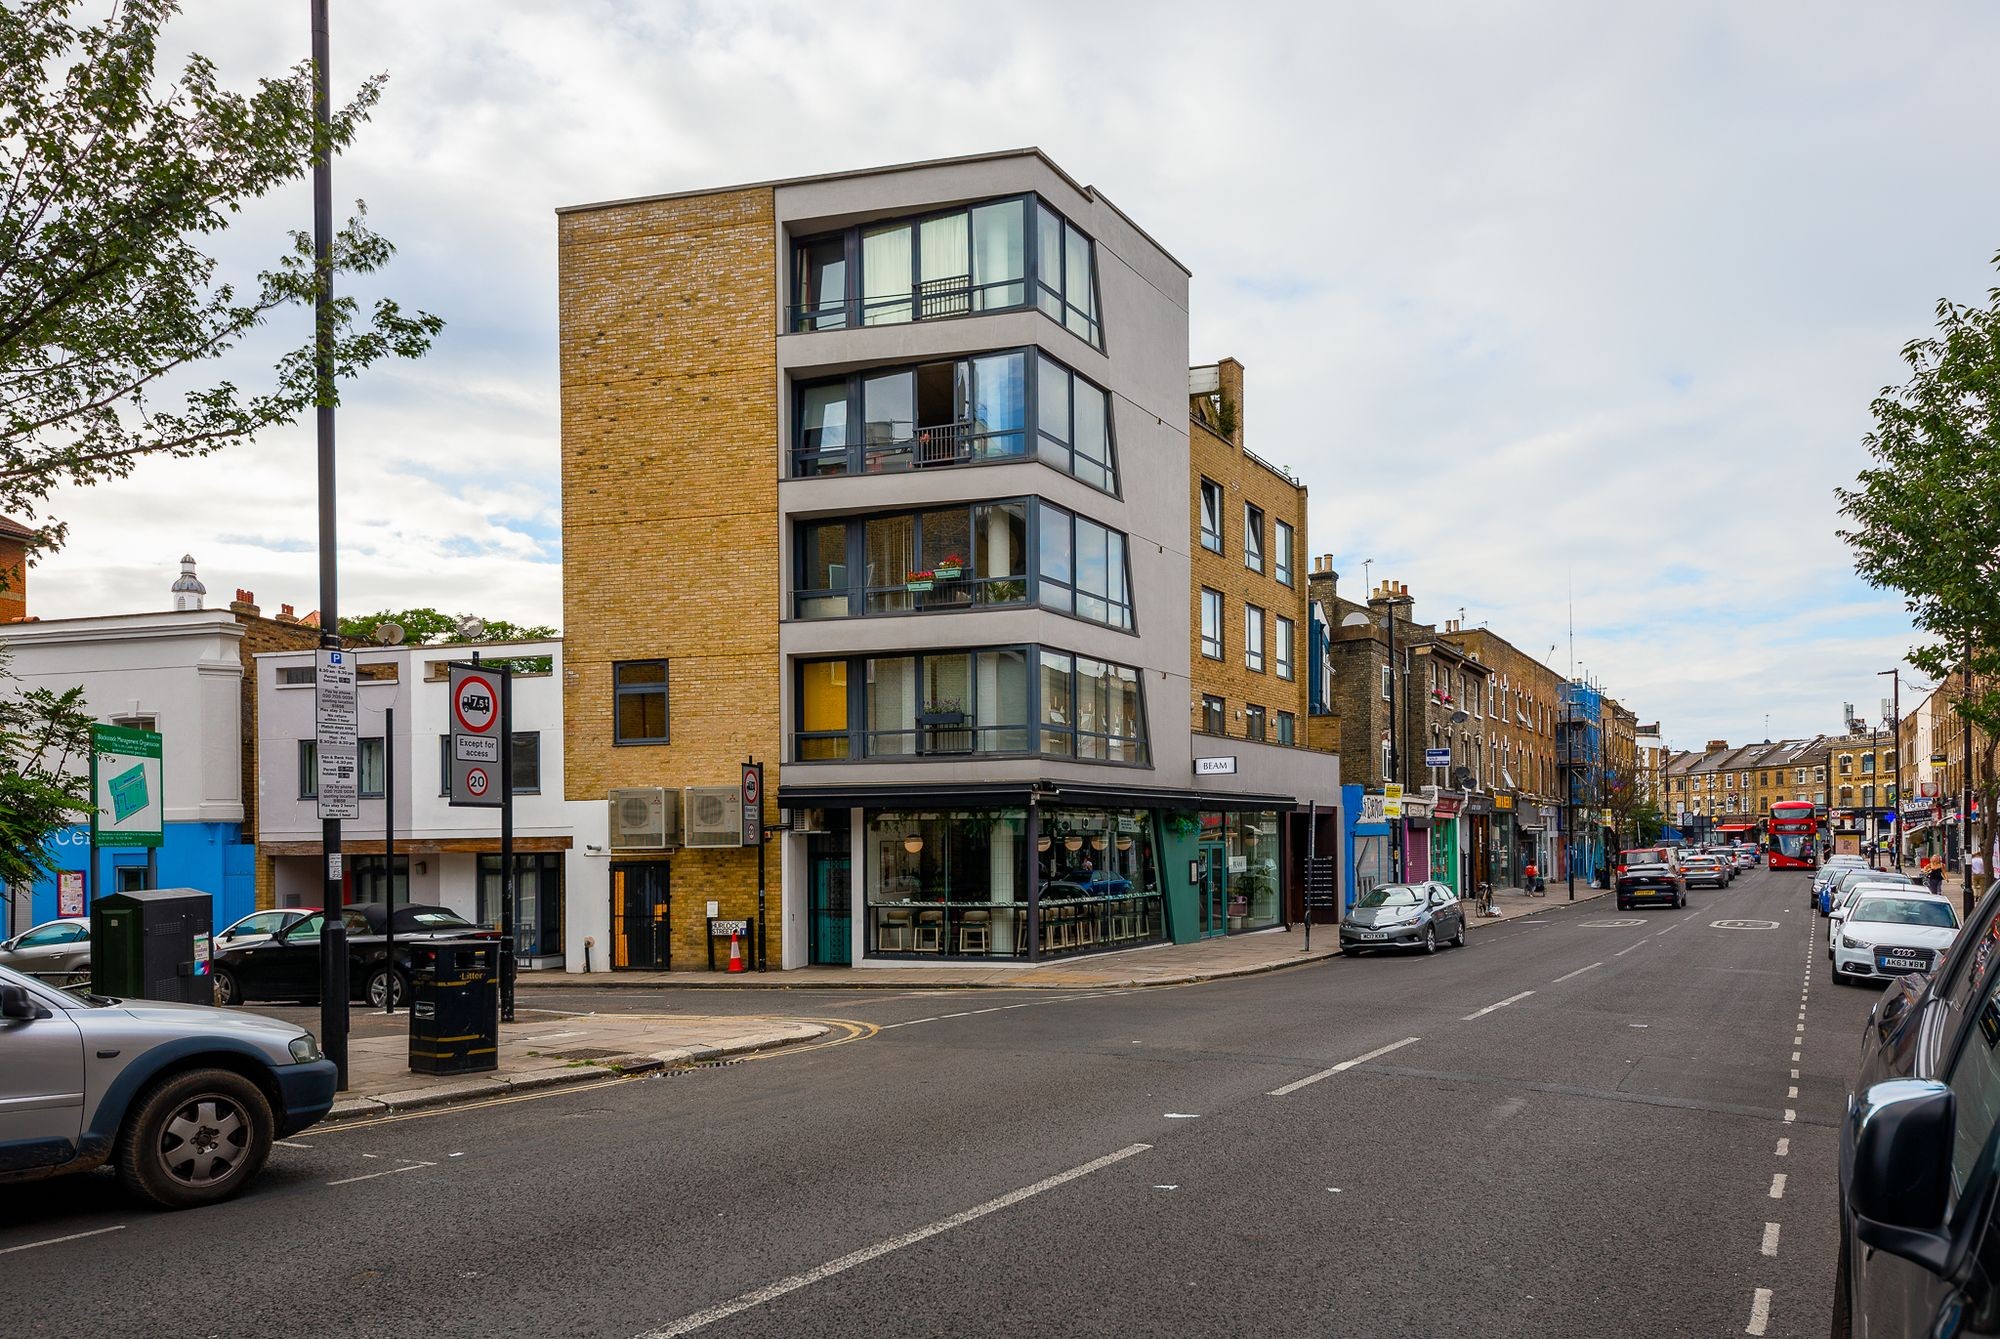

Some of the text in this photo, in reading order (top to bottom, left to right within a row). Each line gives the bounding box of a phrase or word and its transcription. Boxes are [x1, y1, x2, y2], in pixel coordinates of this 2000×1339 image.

[460, 738, 494, 748] Except for
[1204, 762, 1227, 770] BEAM
[470, 776, 484, 787] 20
